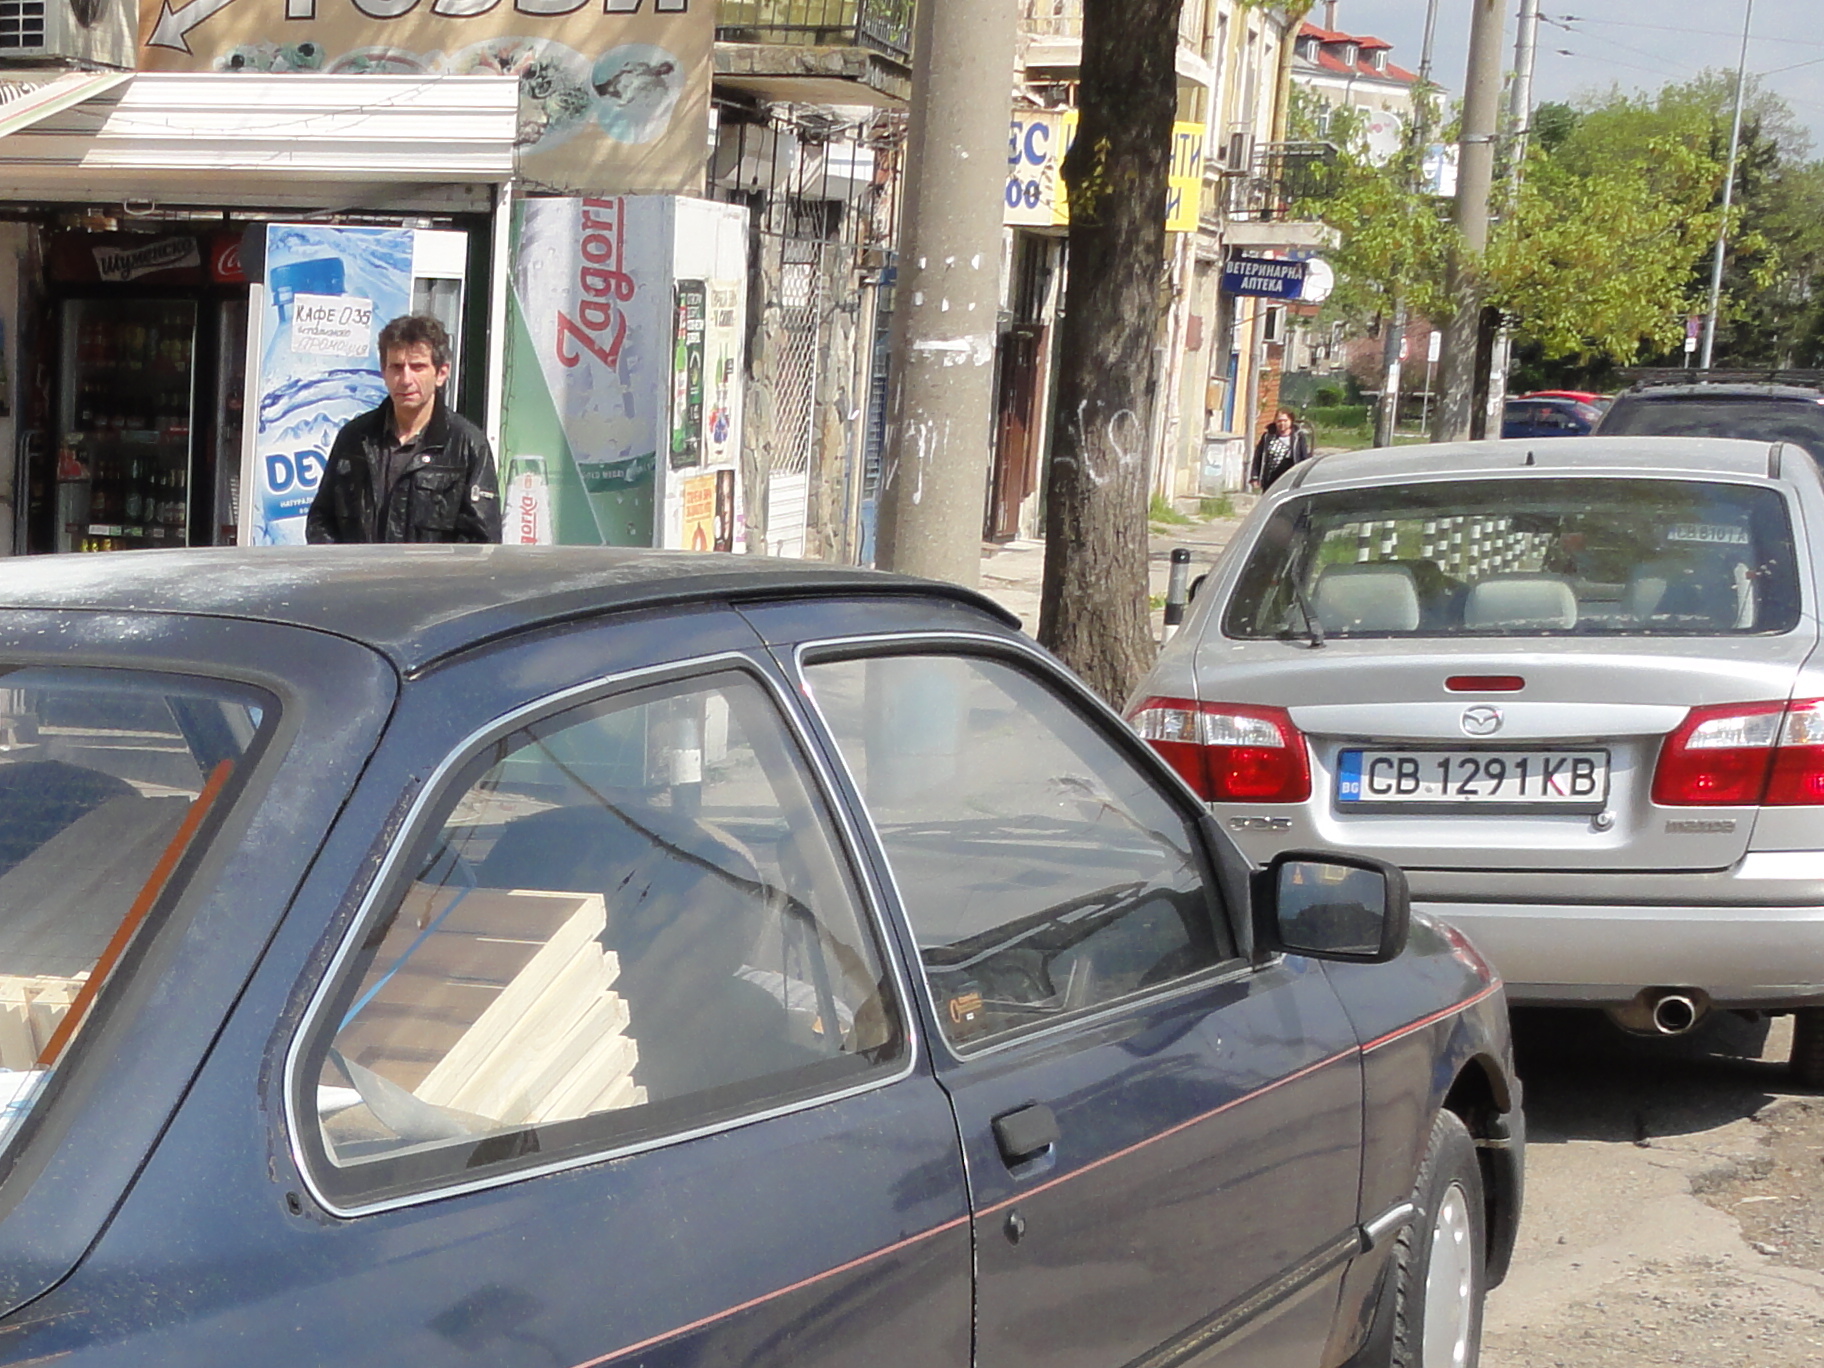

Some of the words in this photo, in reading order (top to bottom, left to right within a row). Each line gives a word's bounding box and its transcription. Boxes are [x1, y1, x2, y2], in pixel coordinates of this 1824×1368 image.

[1226, 261, 1303, 280] ВЕТЕРИНАРНА
[1240, 277, 1283, 293] АПТЕКА
[296, 305, 336, 328] КАФЕ
[1342, 782, 1360, 794] BG
